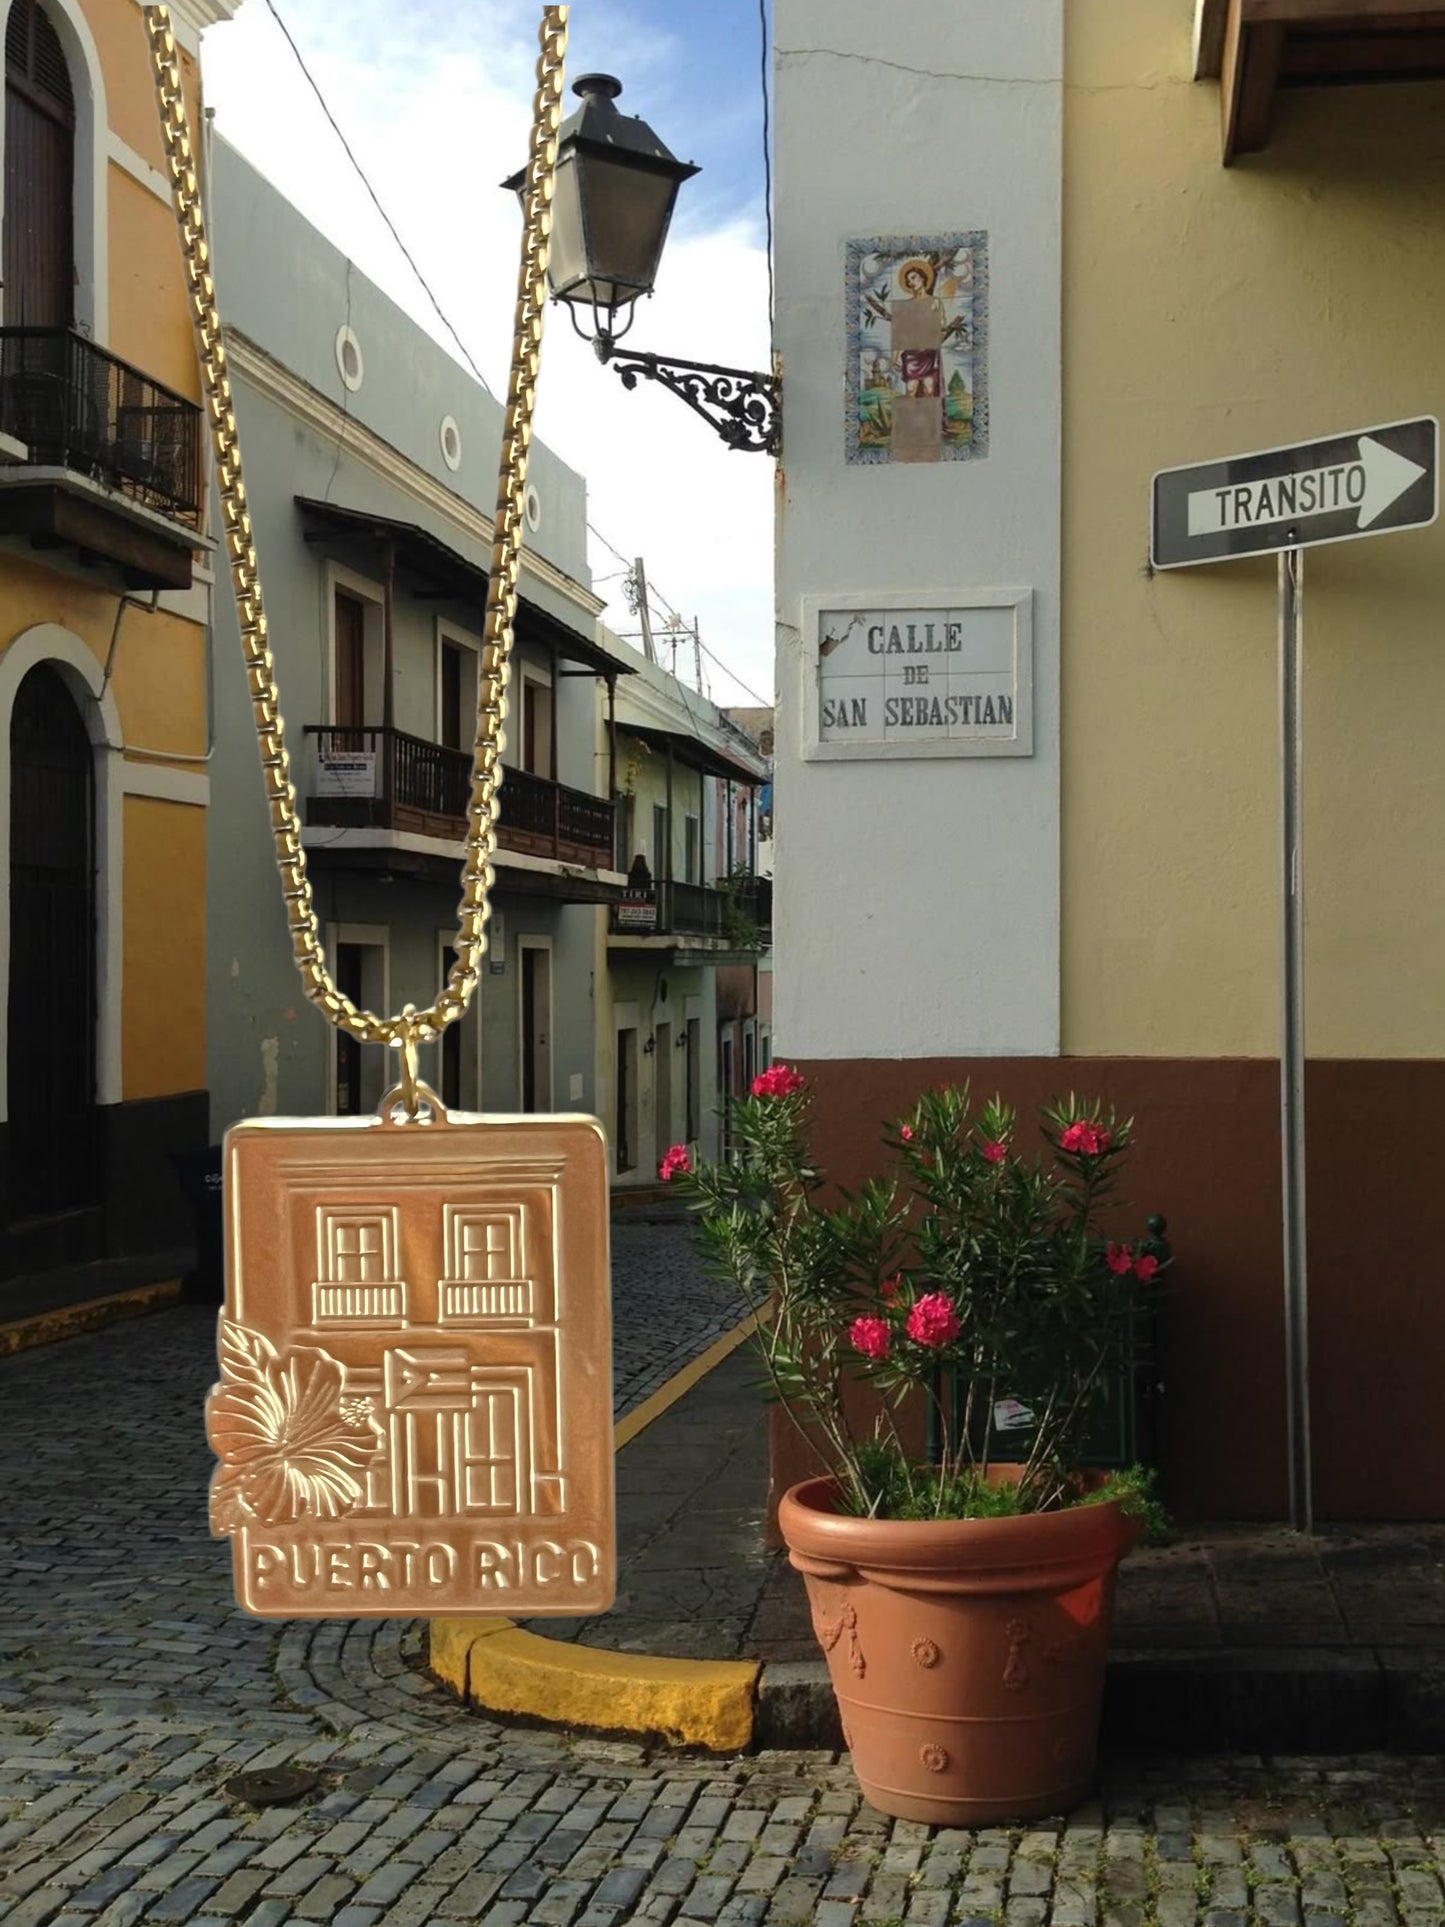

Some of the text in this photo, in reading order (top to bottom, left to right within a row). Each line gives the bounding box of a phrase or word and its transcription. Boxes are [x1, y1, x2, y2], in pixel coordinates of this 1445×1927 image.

[1215, 463, 1366, 526] TRANSITO
[867, 622, 963, 655] CALLE
[903, 665, 929, 685] DE
[822, 695, 1013, 728] SAN SEBASTIAN
[250, 1541, 599, 1591] PUERTO RICO
